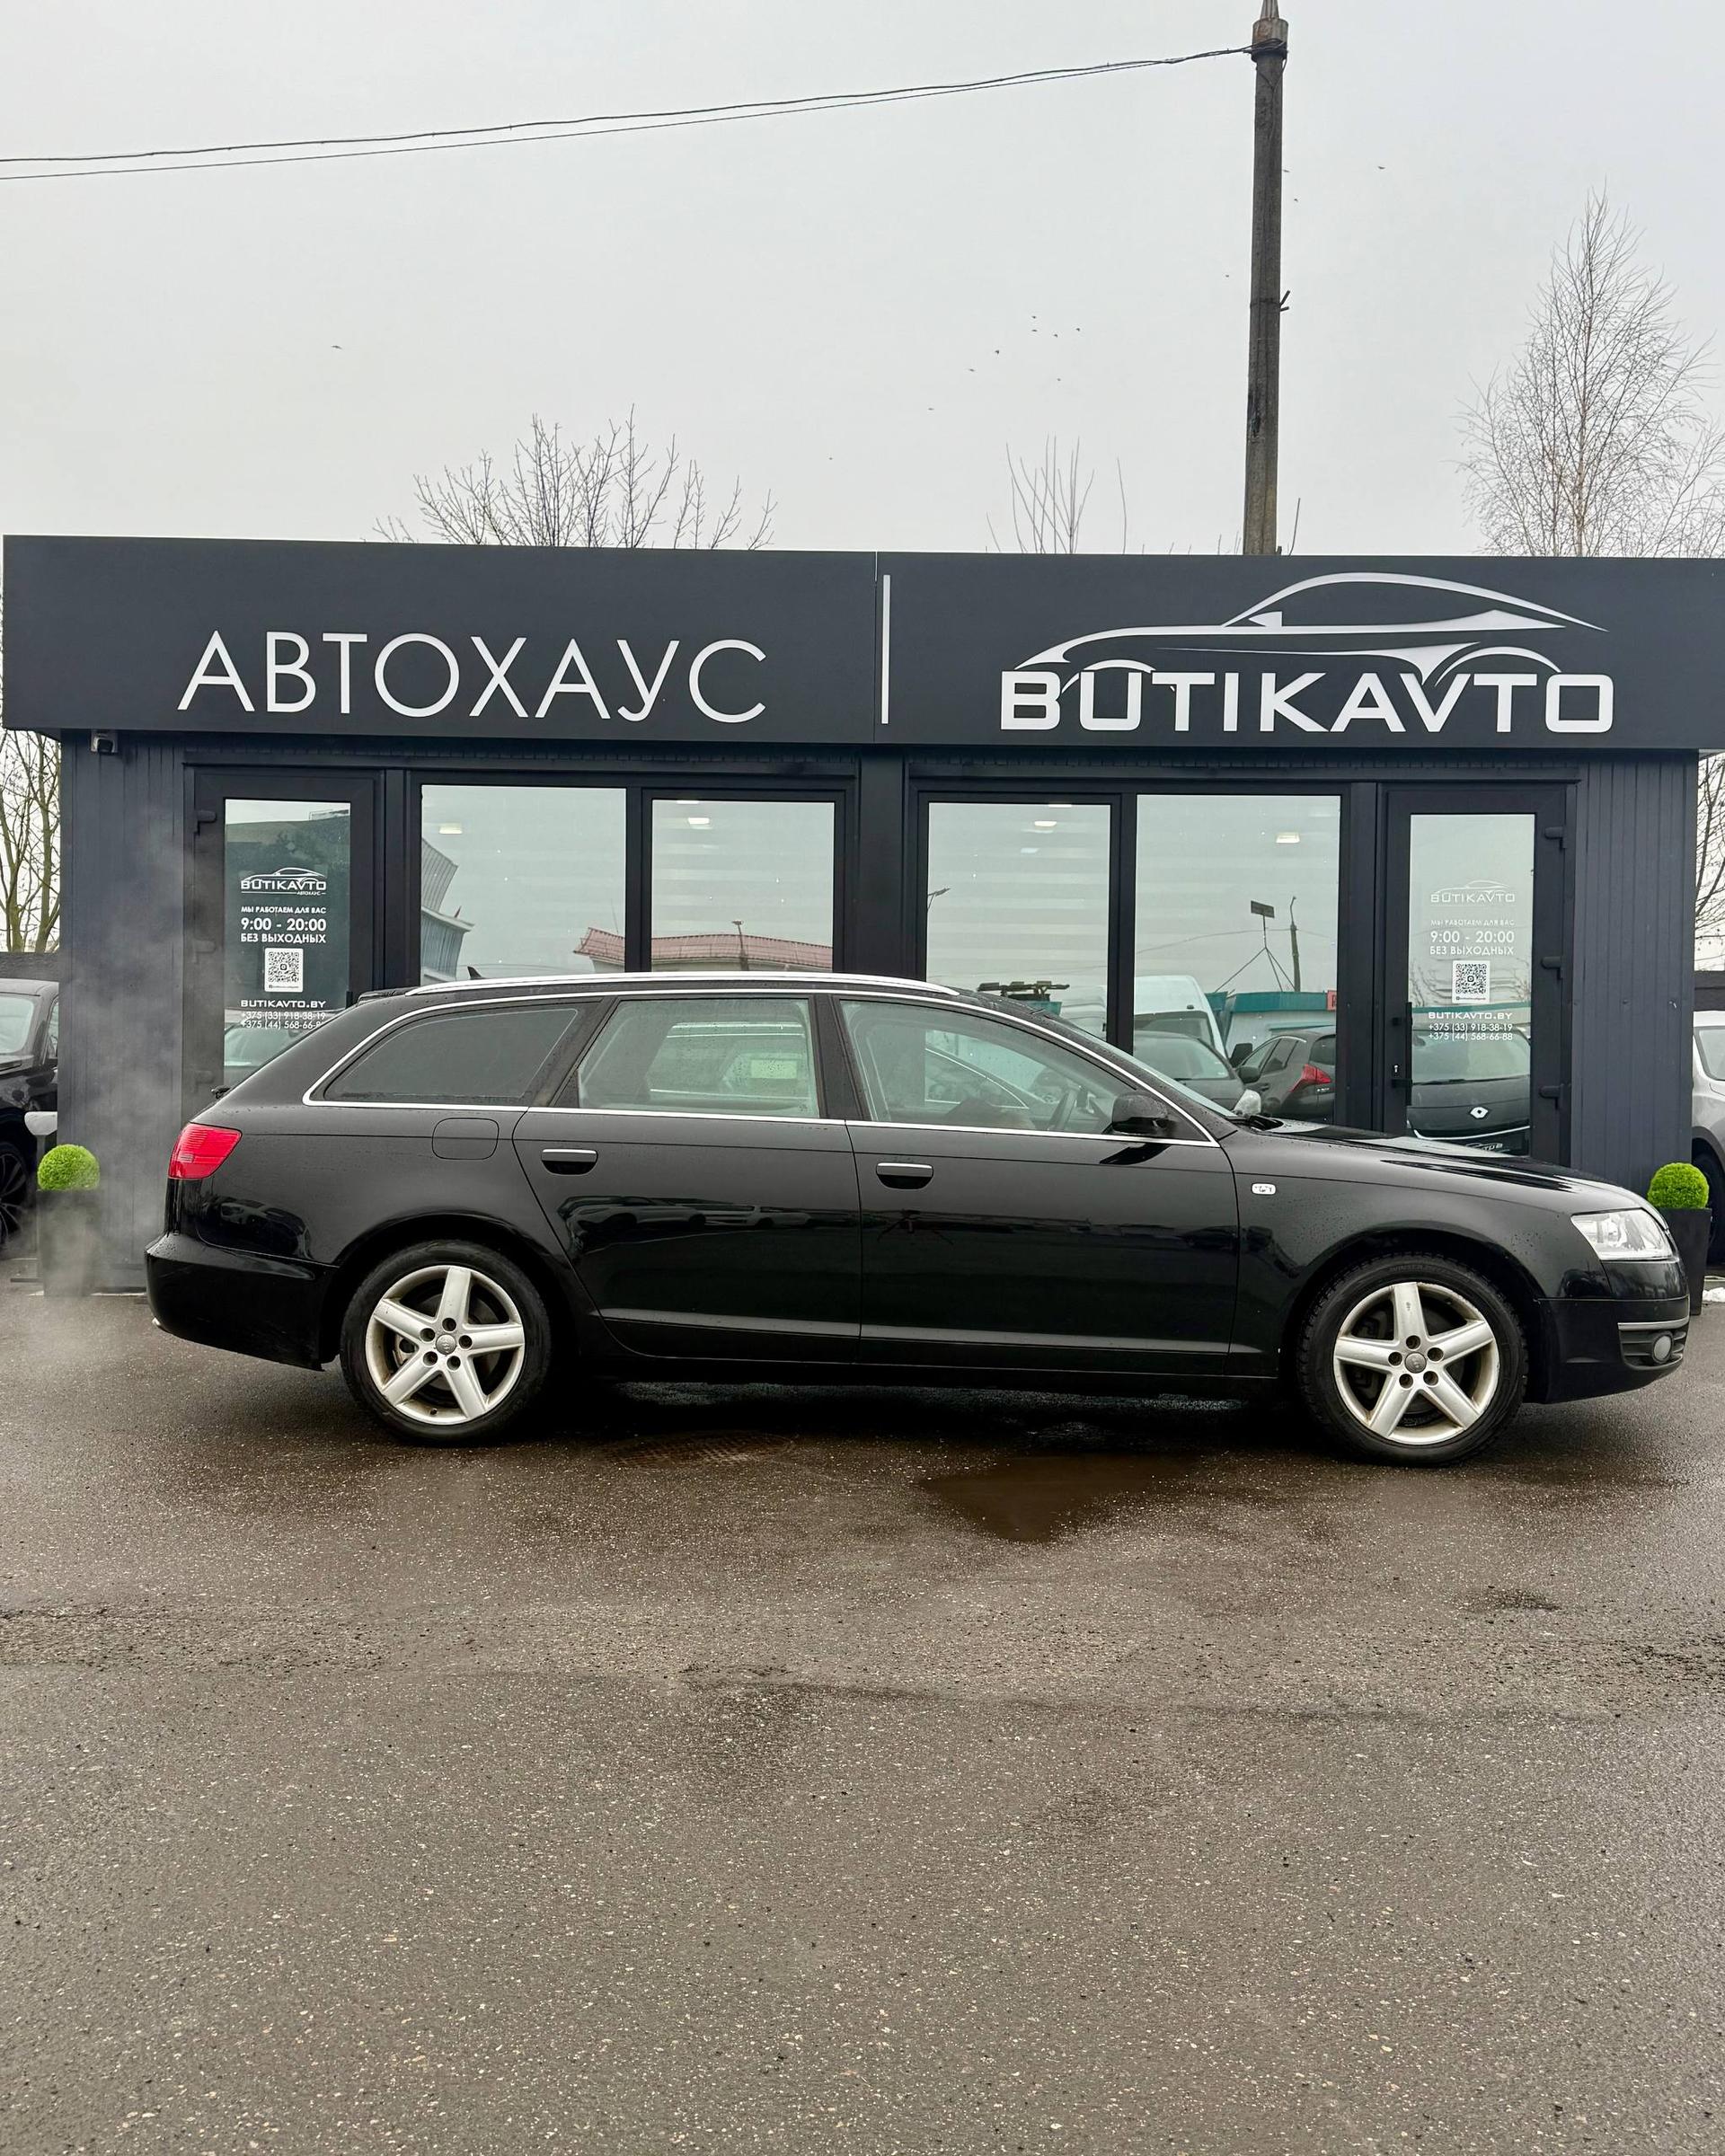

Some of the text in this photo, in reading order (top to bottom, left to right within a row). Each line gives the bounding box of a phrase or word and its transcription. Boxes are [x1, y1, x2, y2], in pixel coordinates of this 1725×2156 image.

[177, 630, 766, 723] АВТОХАУС
[1000, 670, 1614, 733] BUTIKAVTO
[240, 879, 327, 891] BUTIKAVTO
[1430, 893, 1516, 903] BUTIKAVTO
[241, 917, 272, 931] 9:00
[287, 918, 327, 932] 20:00
[240, 933, 326, 943] БЕЗ ВЫХОДНЫХ
[1430, 931, 1460, 943] 9:00
[1475, 931, 1515, 943] 20:00
[1429, 946, 1515, 956] БЕЗ ВЫХОДНЫХ
[240, 1000, 326, 1008] BUTIKAVTO.BY
[241, 1011, 326, 1021] +375 (33) 918-38-19
[1428, 1012, 1513, 1020] BUTIKAVTO.BY
[264, 1020, 281, 1030] (44)
[1429, 1023, 1513, 1033] +375 (33) 918-38-19
[1452, 1032, 1468, 1042] (44)
[1471, 1032, 1513, 1041] 568-66-88
